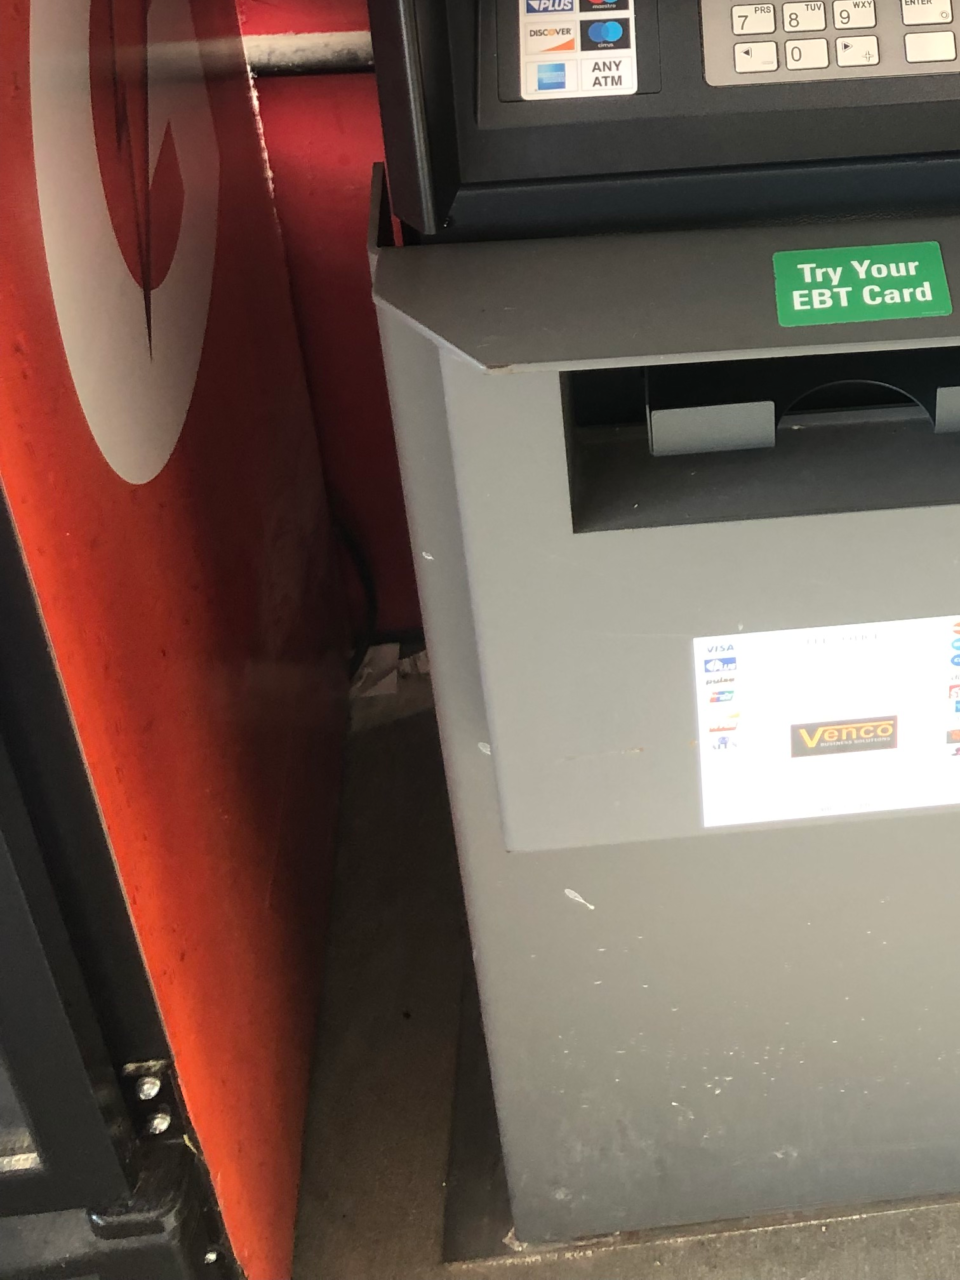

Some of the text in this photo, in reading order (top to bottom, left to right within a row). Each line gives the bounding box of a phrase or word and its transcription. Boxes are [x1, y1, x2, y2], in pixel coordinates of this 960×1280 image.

[737, 6, 772, 30] 7 PRS
[788, 2, 822, 28] 8 TUV
[838, 0, 873, 25] 9 WXY
[529, 28, 572, 37] DISCOVER
[790, 46, 803, 62] 0
[591, 60, 623, 73] ANY
[592, 75, 623, 88] ATM
[796, 259, 920, 286] Try Your
[792, 281, 933, 311] EBT Card
[706, 643, 735, 654] VISA
[798, 721, 895, 748] Venco
